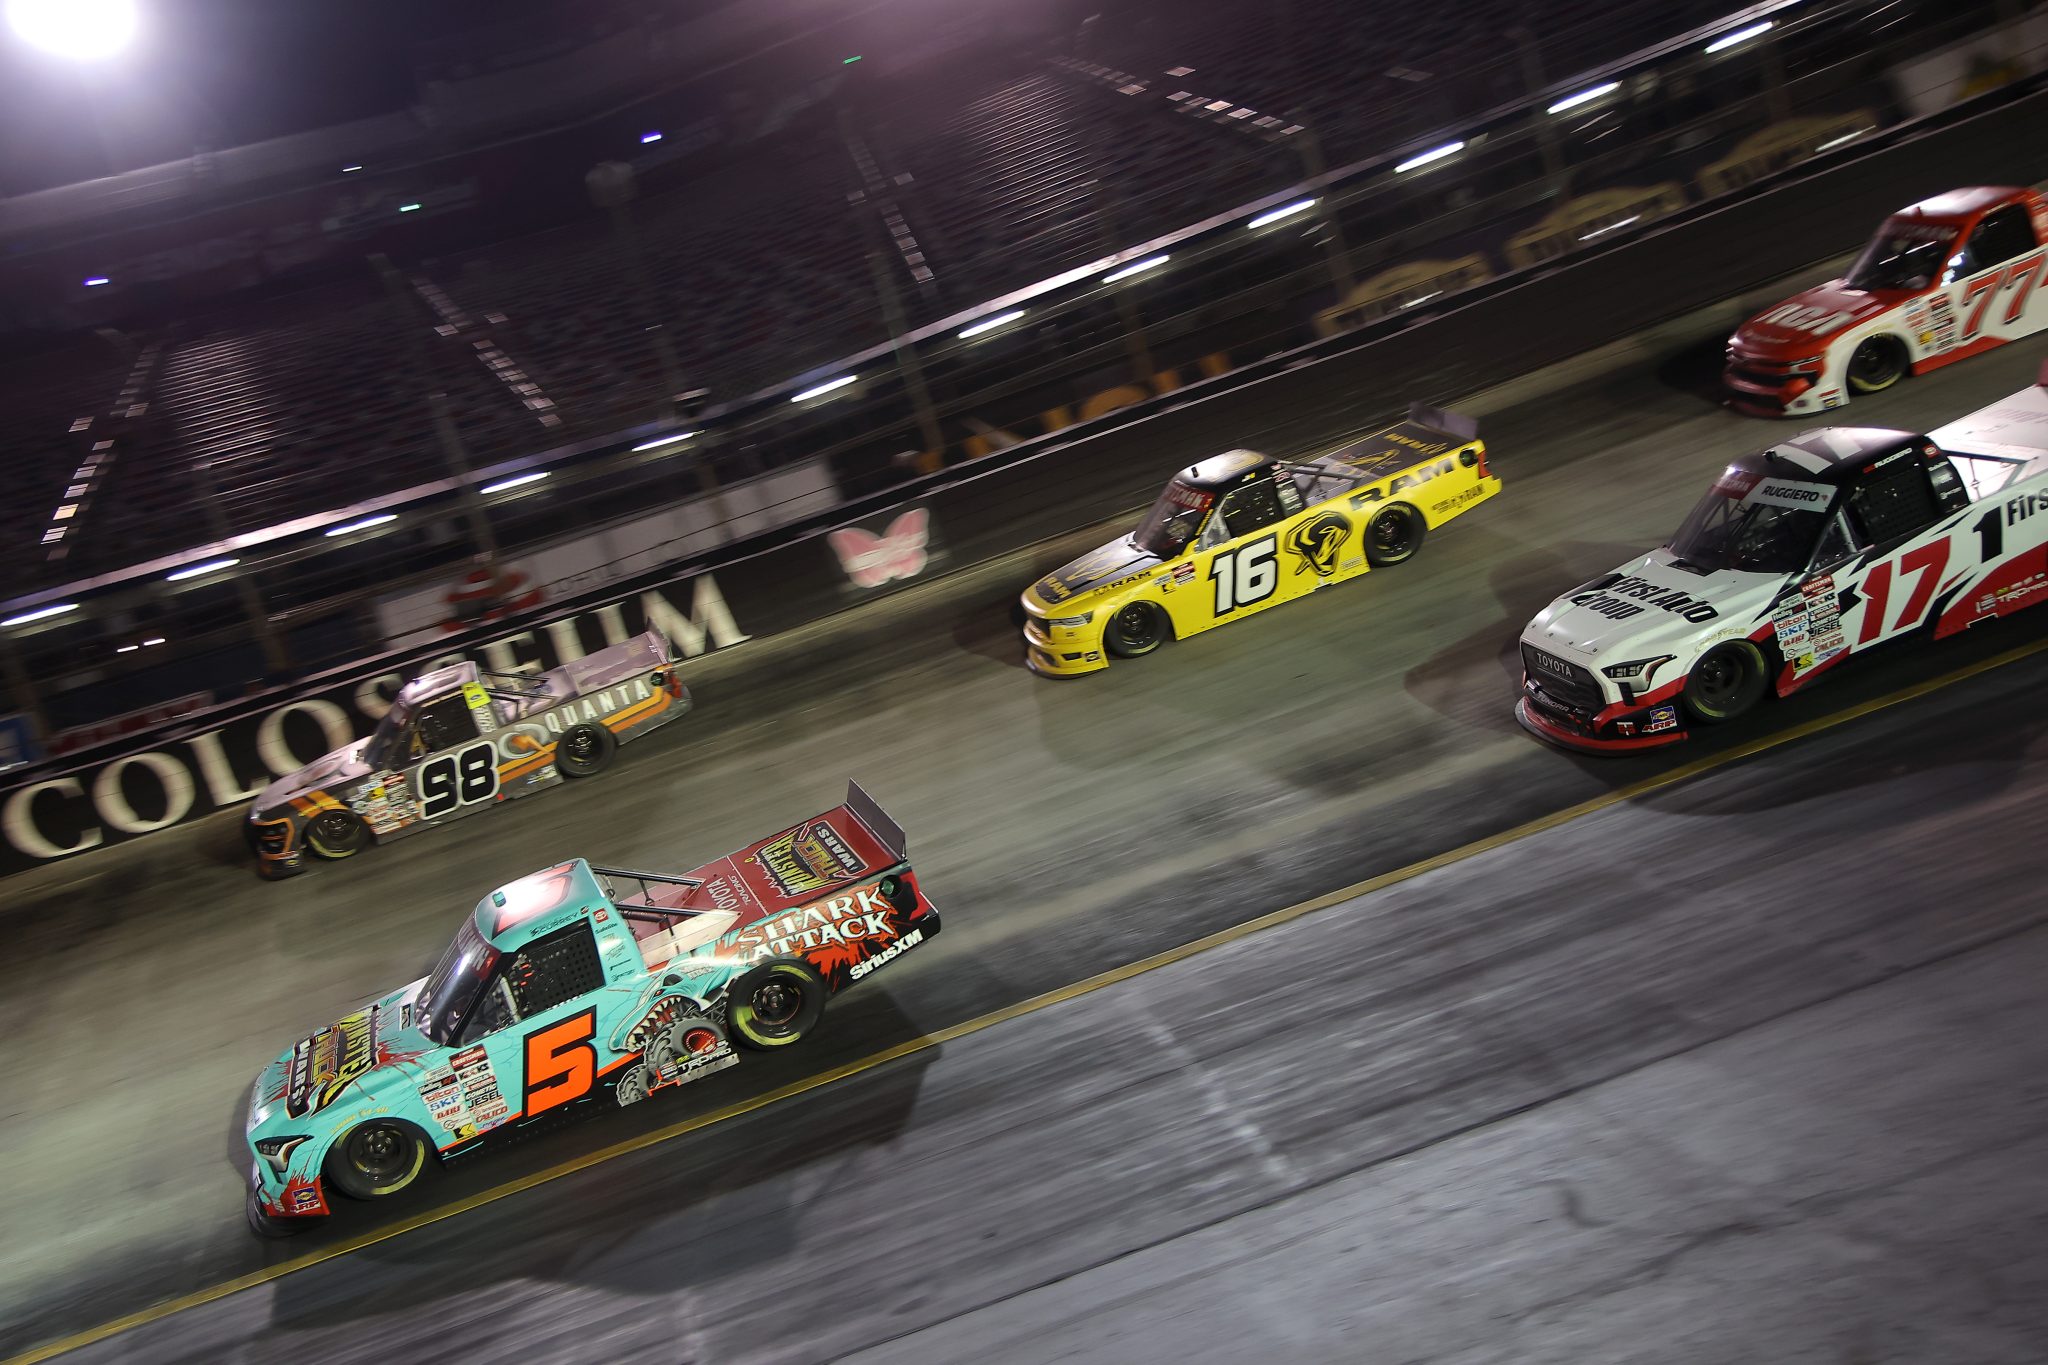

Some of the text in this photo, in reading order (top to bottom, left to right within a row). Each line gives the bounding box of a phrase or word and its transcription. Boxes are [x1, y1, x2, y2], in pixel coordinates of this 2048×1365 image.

[1960, 250, 2046, 340] 77
[1349, 458, 1455, 511] RAM
[1762, 484, 1820, 502] RUGGIERO
[1111, 570, 1152, 589] RAM
[1208, 532, 1278, 618] 16
[1857, 535, 1952, 646] 17
[1571, 590, 1646, 620] Group
[1611, 575, 1719, 624] First Auto
[1776, 614, 1807, 630] tilton
[1779, 621, 1808, 639] SKF
[1812, 621, 1842, 637] JESEL
[1536, 652, 1572, 678] TOYOTA
[544, 679, 651, 734] QUANTA
[1642, 719, 1676, 732] ARP
[416, 741, 500, 820] 98
[706, 876, 741, 912] TOYOTA
[727, 874, 751, 905] RACING
[736, 885, 891, 945] SHARK
[752, 909, 895, 961] ATTACK
[849, 928, 924, 981] SiriusXM
[522, 1005, 596, 1117] 5
[425, 1086, 459, 1102] tilton
[430, 1094, 461, 1112] SKF
[468, 1091, 502, 1108] JESEL
[476, 1106, 508, 1123] CALICO
